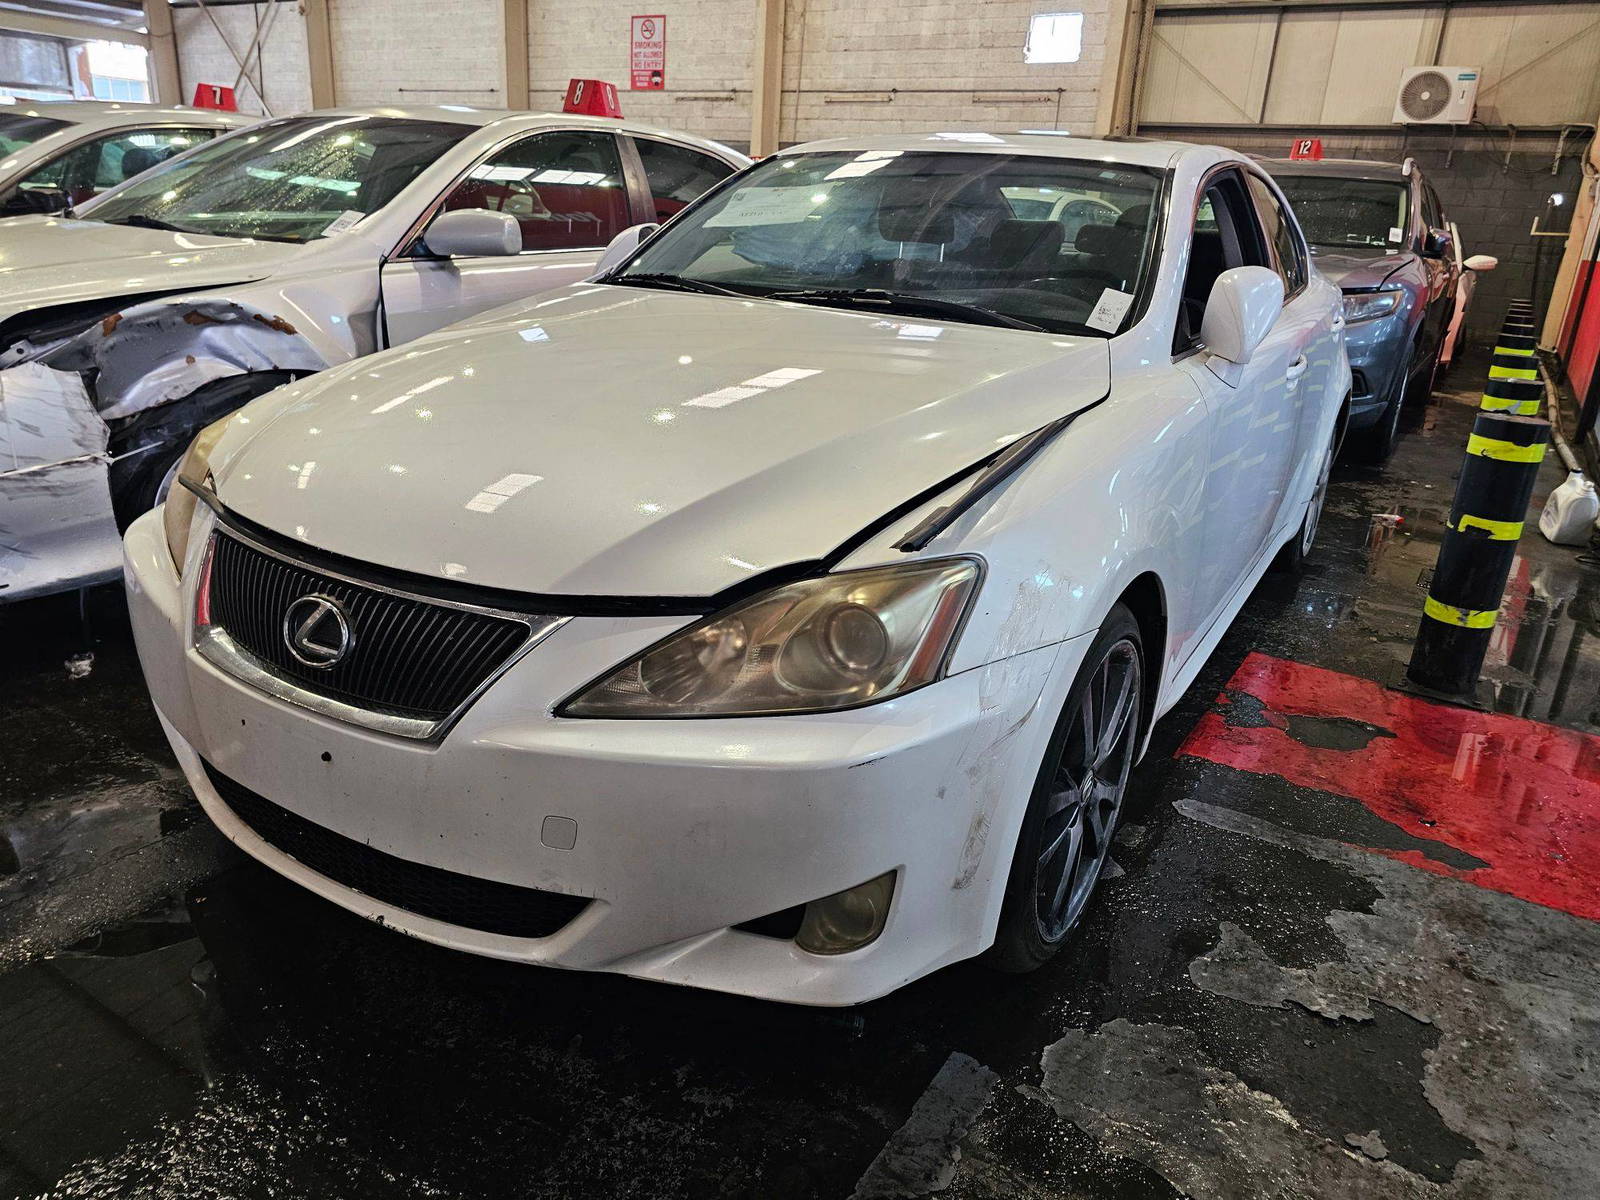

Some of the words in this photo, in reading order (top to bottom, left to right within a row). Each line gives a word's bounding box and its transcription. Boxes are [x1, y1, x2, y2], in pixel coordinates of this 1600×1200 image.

[634, 41, 662, 49] SMOKING
[643, 61, 661, 69] ENTRY
[212, 87, 221, 105] 7
[573, 80, 584, 105] 8
[1299, 140, 1312, 155] 12
